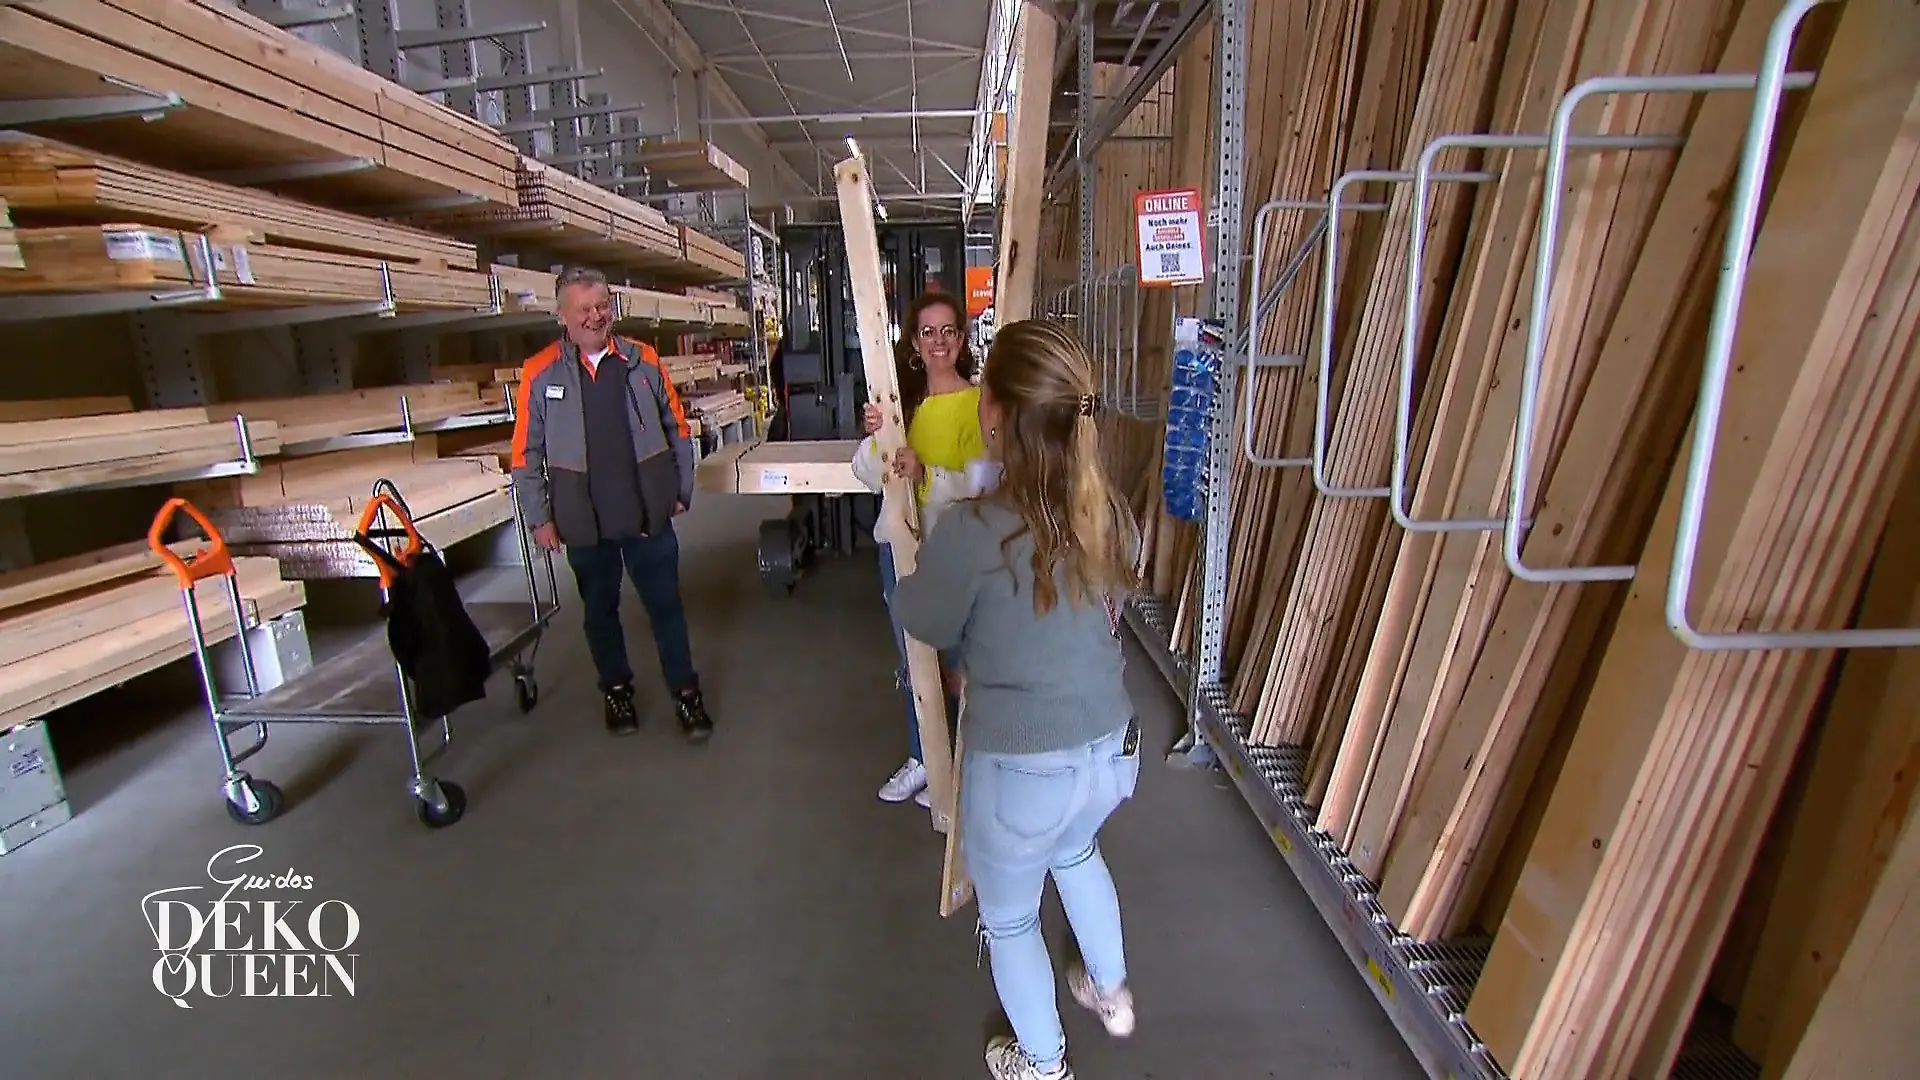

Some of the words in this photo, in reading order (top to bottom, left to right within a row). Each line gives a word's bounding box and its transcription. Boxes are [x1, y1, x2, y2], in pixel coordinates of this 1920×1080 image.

[1145, 197, 1188, 212] ONLINE
[1148, 217, 1168, 227] Noch
[1168, 217, 1188, 226] mehr
[1145, 243, 1164, 252] Auch
